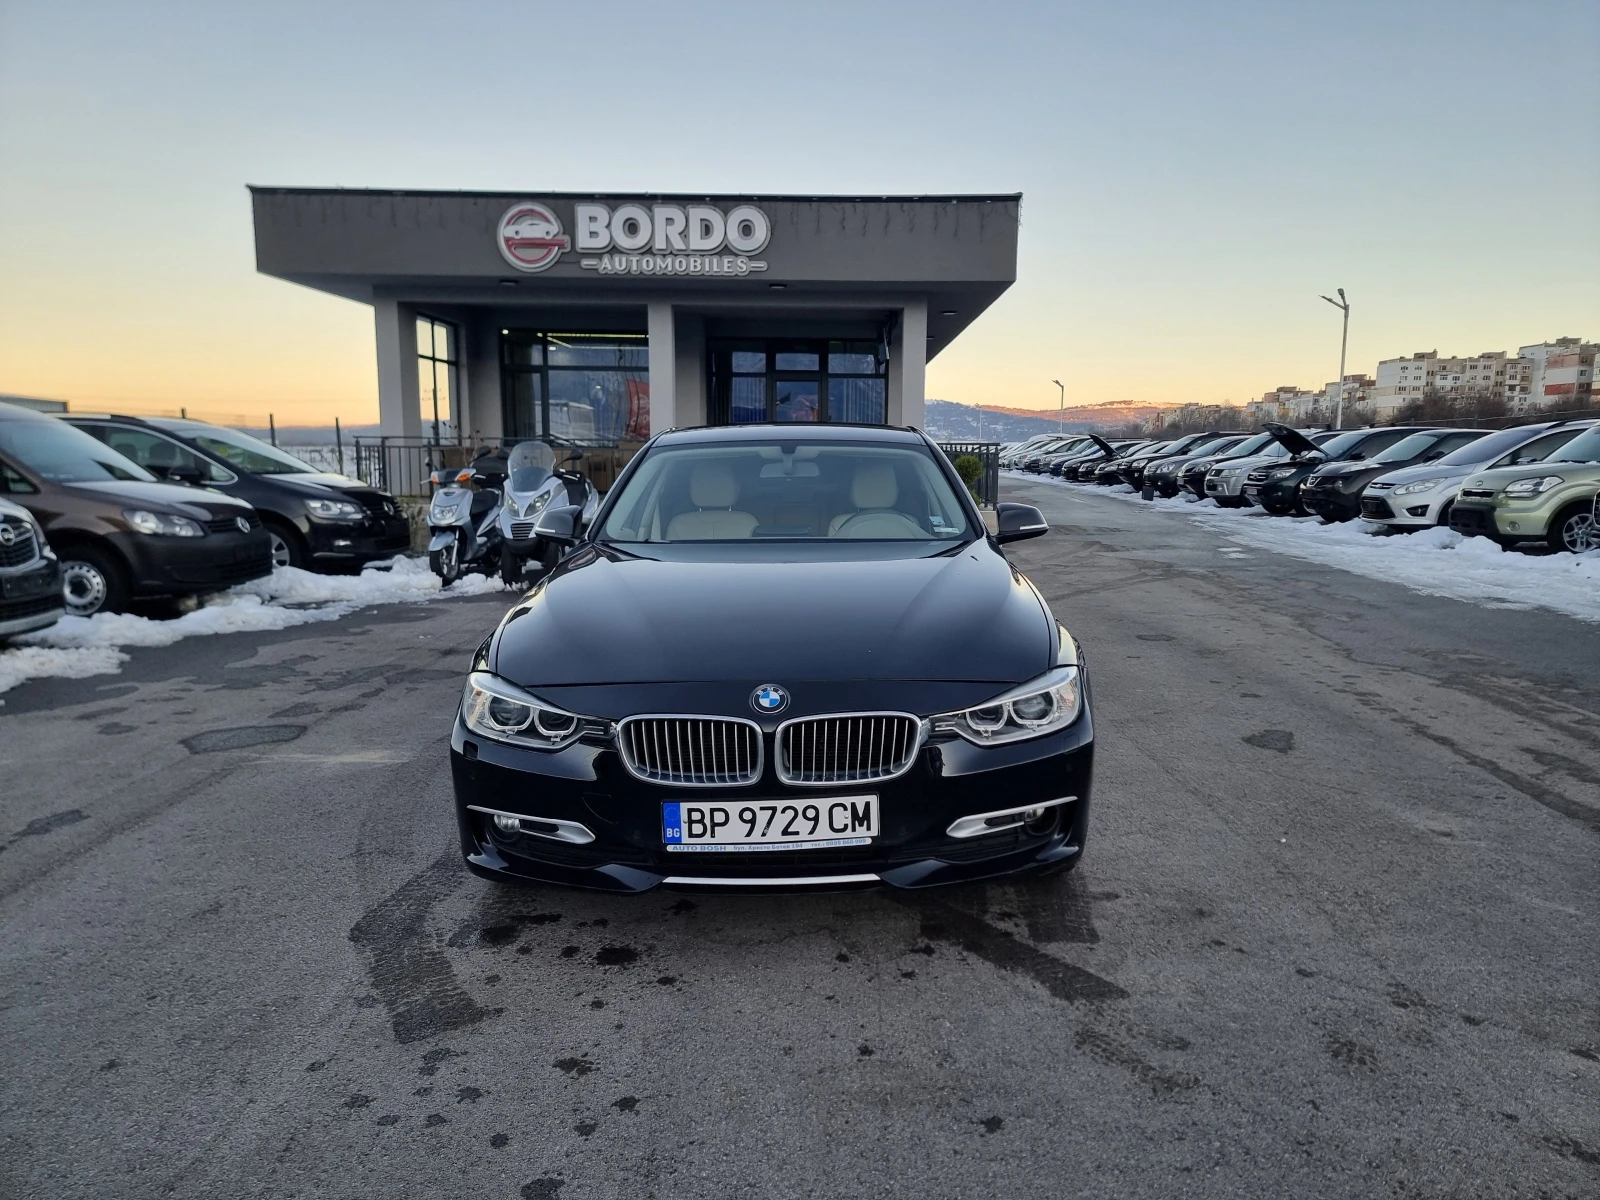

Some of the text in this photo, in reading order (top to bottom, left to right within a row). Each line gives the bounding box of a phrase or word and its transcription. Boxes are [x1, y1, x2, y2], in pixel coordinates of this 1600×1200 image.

[577, 205, 768, 251] BORDO
[599, 256, 748, 273] AUTOMOBILES
[666, 828, 680, 838] BG
[687, 801, 872, 839] BP 9729 CM
